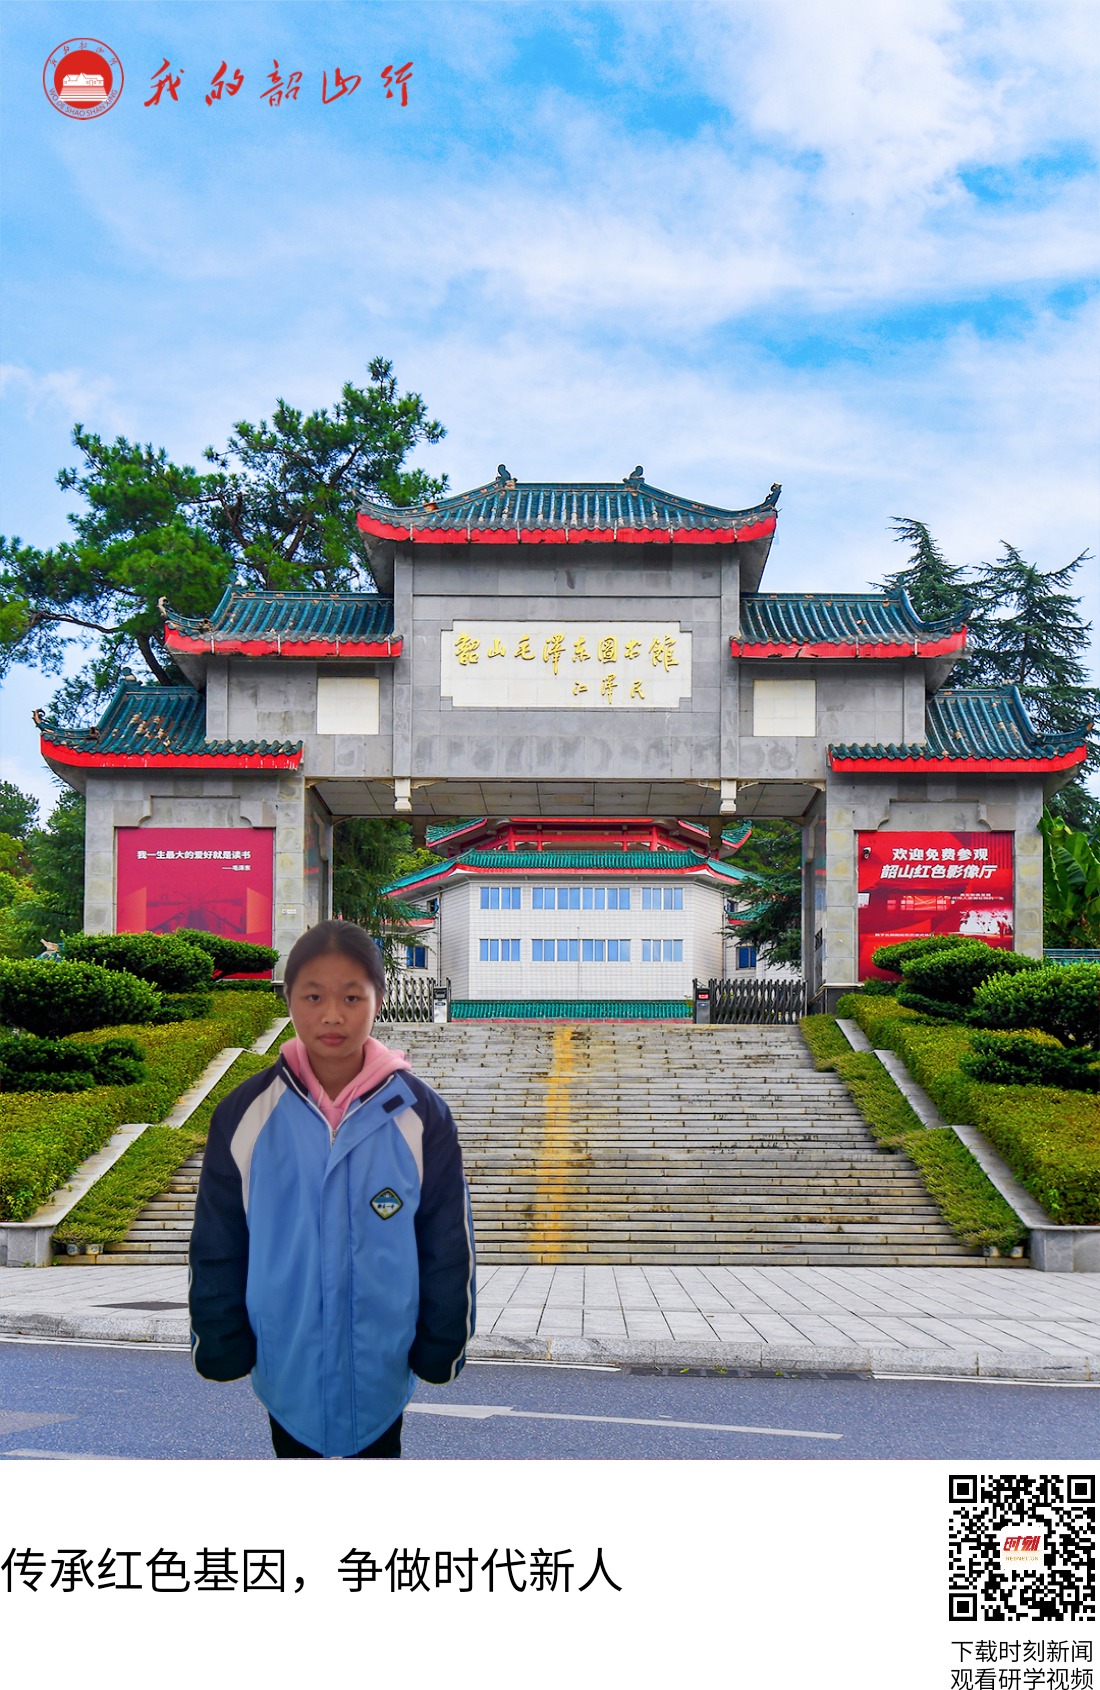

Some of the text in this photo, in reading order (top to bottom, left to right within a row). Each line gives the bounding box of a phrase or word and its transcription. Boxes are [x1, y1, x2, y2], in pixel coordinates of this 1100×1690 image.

[137, 850, 251, 860] 我一生最大的爱好就是读书
[892, 848, 988, 861] 欢迎免费参观
[880, 864, 998, 879] 韶山红色影像厅
